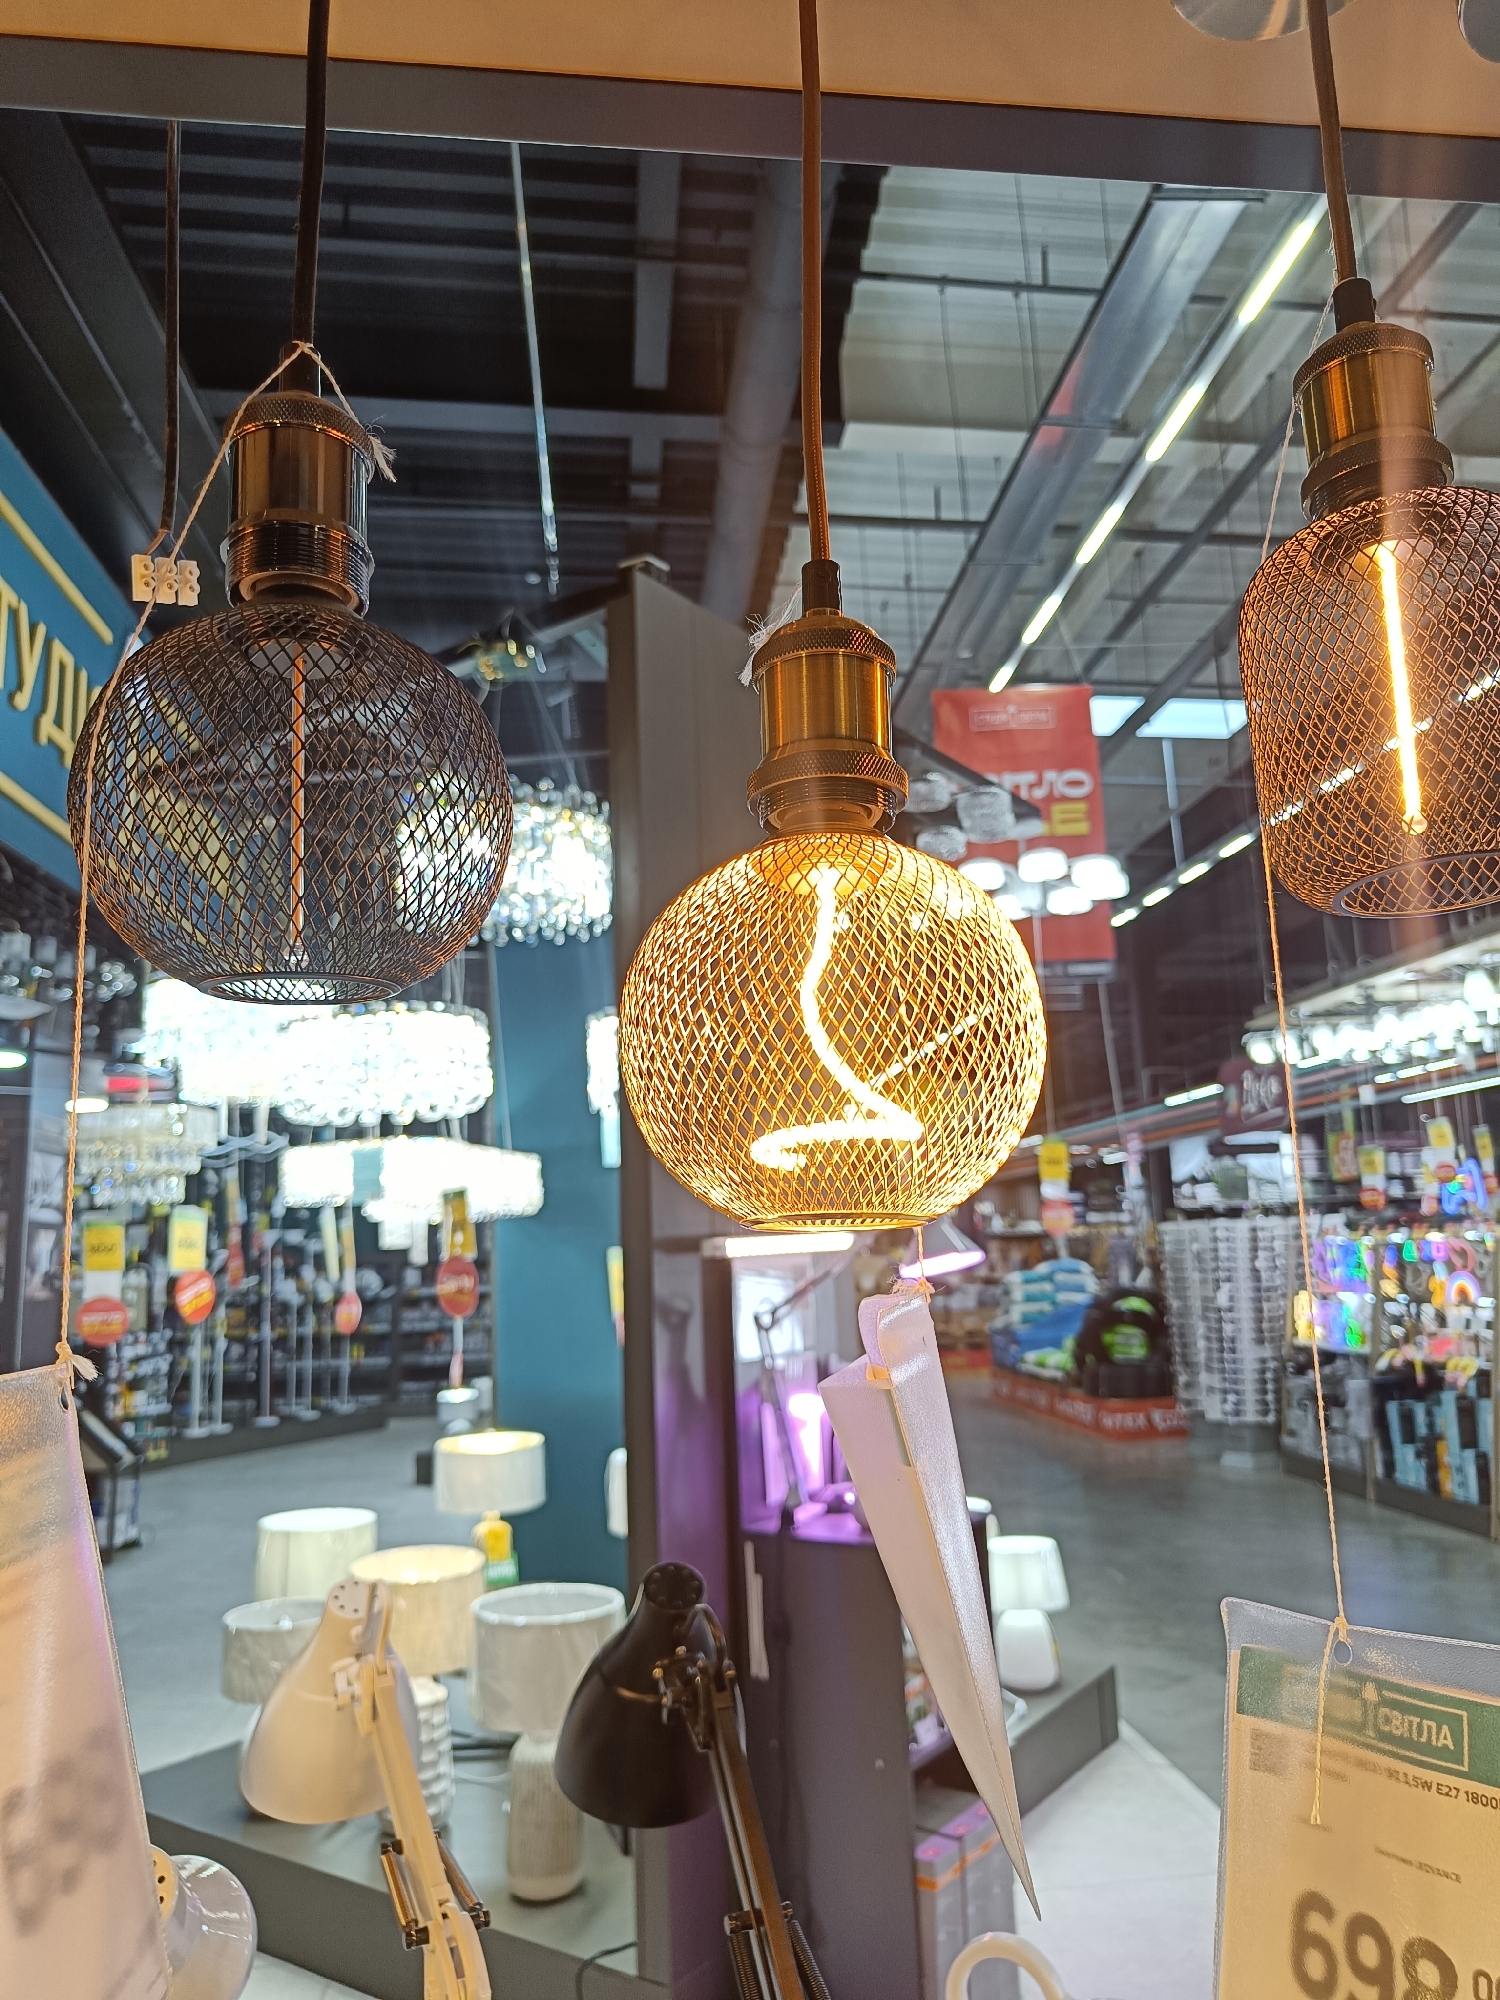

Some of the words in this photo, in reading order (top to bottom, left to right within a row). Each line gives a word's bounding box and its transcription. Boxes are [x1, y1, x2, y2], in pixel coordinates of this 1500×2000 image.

[1379, 1707, 1455, 1751] СВІТЛА
[1435, 1782, 1461, 1800] E27
[1463, 1790, 1500, 1811] 1800
[1290, 1888, 1458, 2000] 698
